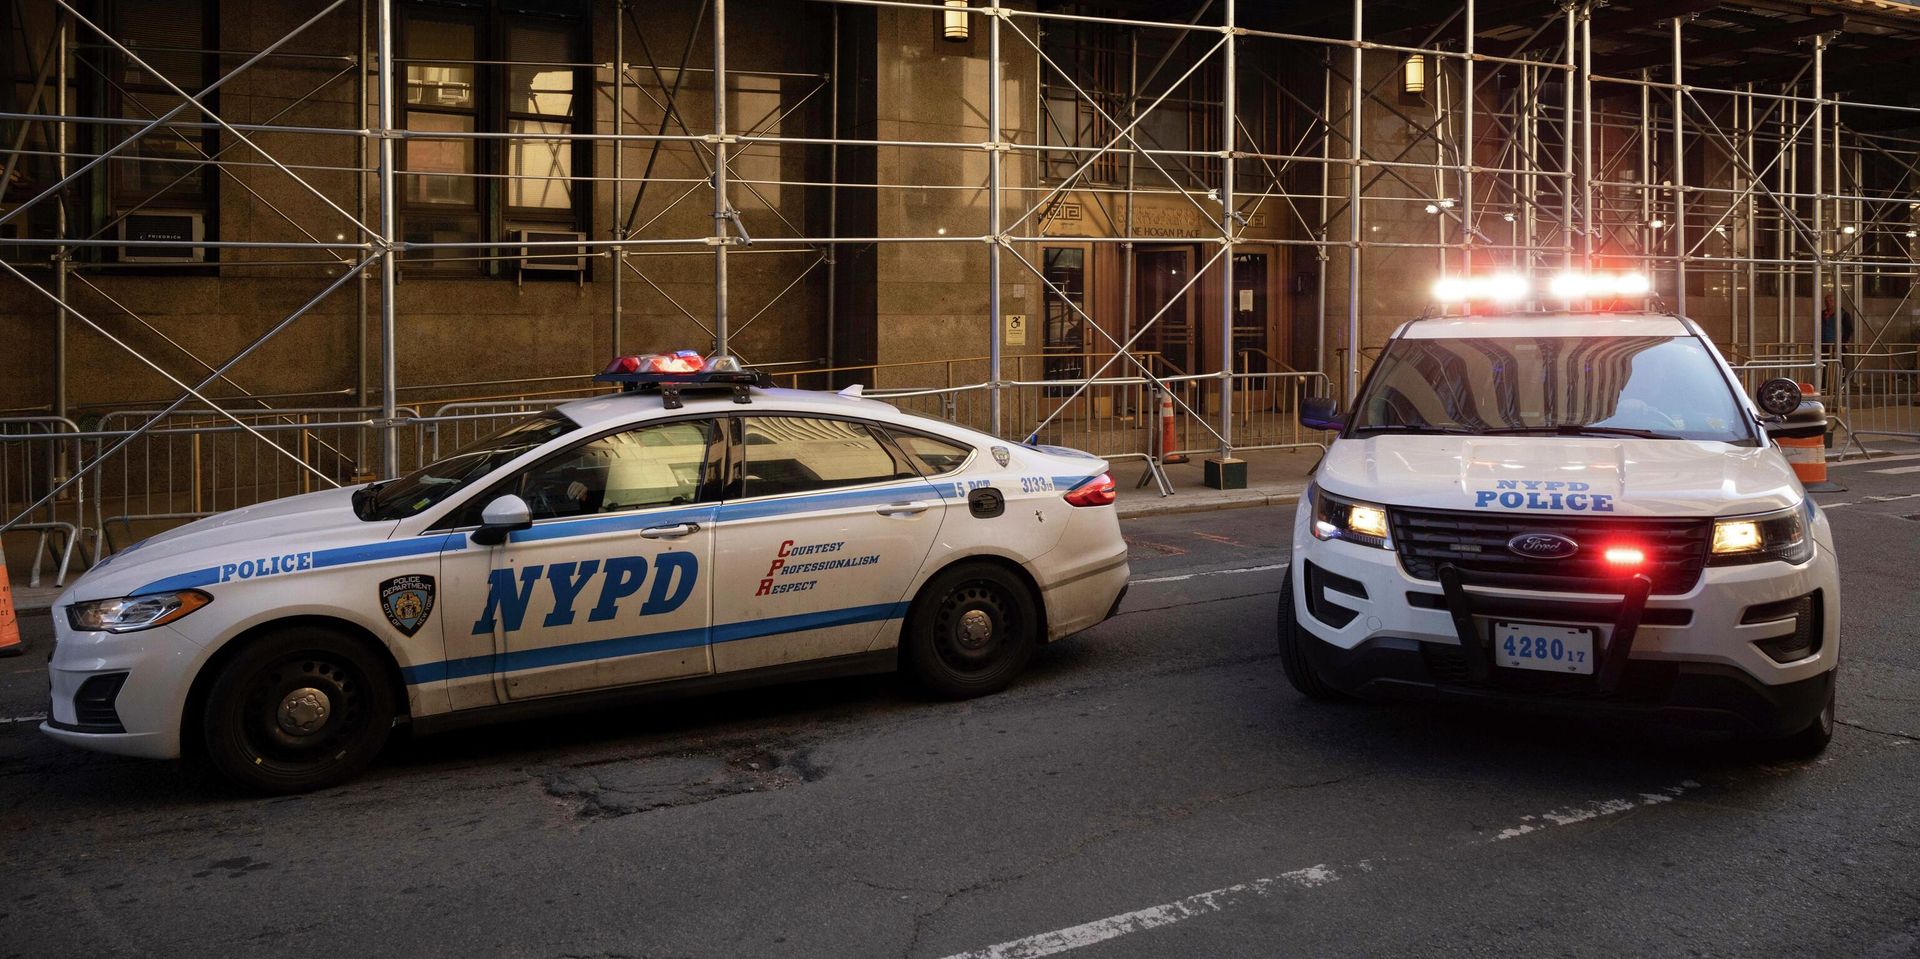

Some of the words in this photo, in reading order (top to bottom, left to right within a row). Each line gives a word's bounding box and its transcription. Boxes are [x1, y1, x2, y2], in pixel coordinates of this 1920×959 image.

[1144, 227, 1175, 237] HOGAN
[1176, 228, 1201, 238] PLACE
[956, 482, 965, 498] 5
[1496, 480, 1590, 492] NYPD
[1474, 491, 1614, 512] POLICE
[778, 540, 845, 558] COURTESY
[1522, 536, 1562, 552] Ford
[221, 552, 311, 582] POLICE
[766, 555, 880, 577] PROFESSIONALISM
[393, 576, 421, 586] POLICE
[755, 579, 818, 597] RESPECT
[383, 583, 432, 598] DEPARTMENT
[472, 551, 699, 635] NYPD
[383, 603, 395, 618] CITY
[391, 618, 402, 627] OF
[416, 611, 428, 626] NEW
[424, 595, 434, 612] YORK
[1503, 634, 1564, 661] 4280
[1567, 650, 1585, 663] 17
